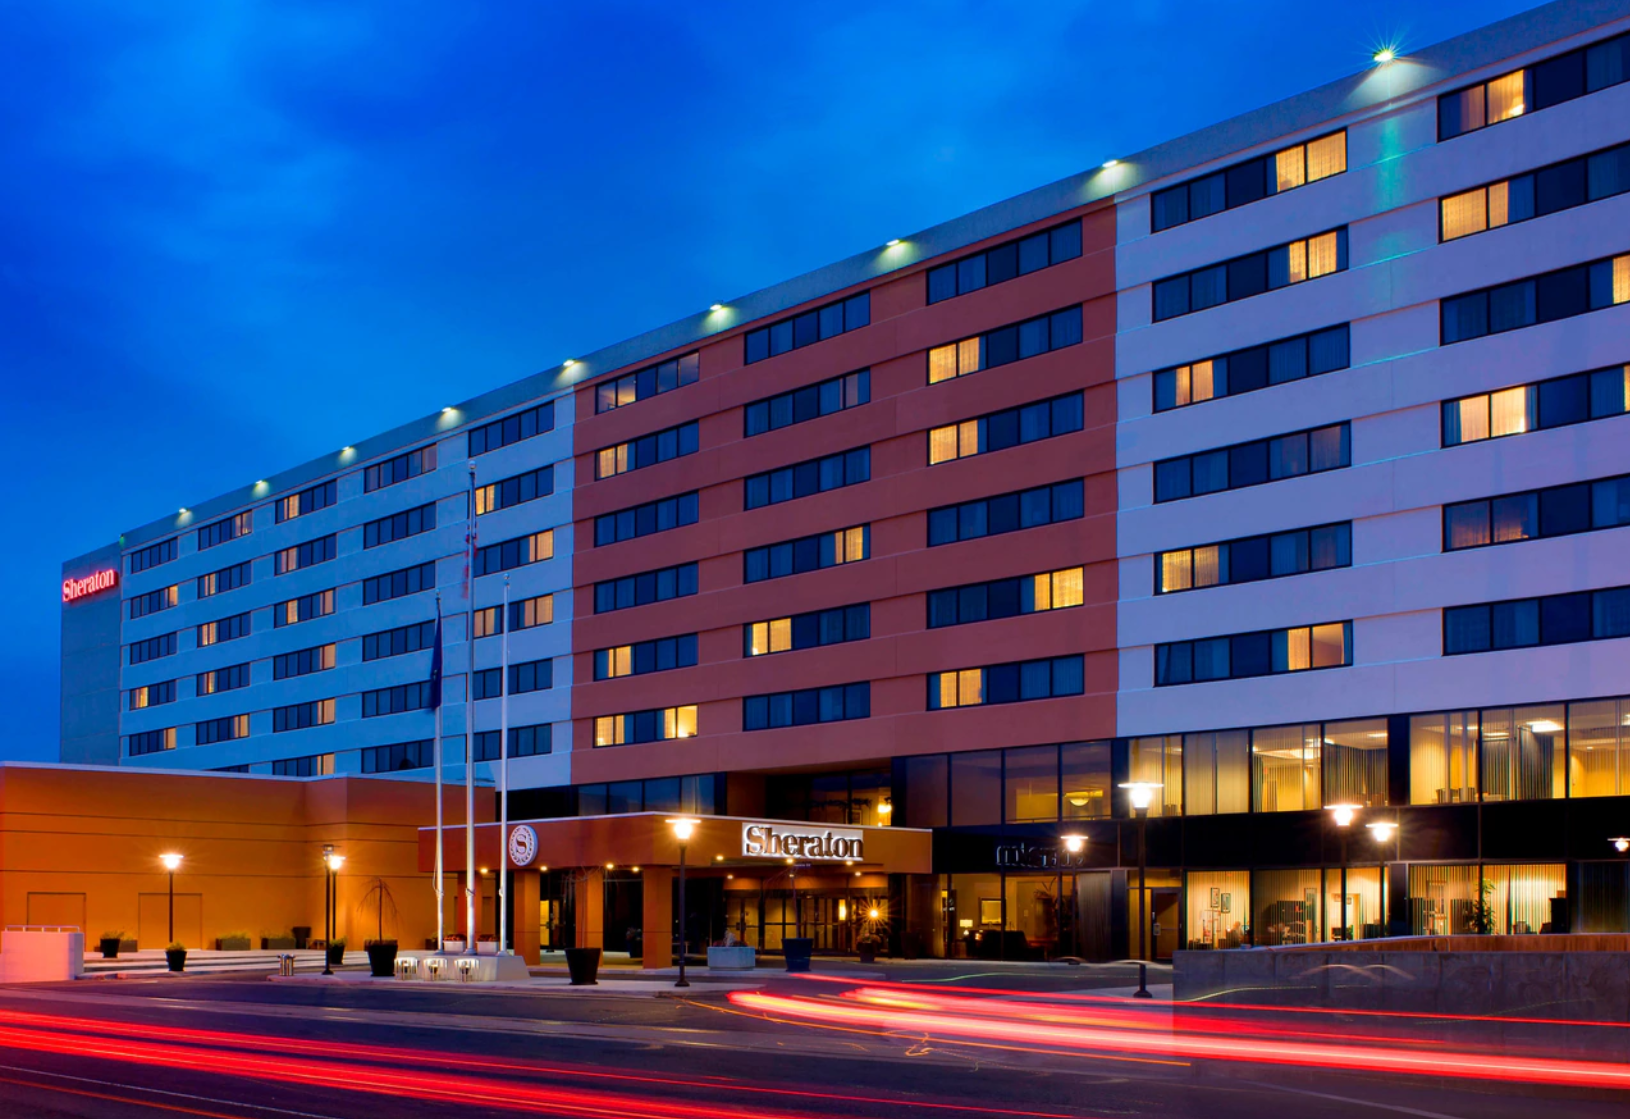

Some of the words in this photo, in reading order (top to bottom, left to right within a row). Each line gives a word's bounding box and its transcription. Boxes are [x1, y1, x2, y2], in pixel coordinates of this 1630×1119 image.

[62, 569, 116, 602] Sheraton
[515, 833, 528, 855] S
[745, 825, 863, 858] Sheraton
